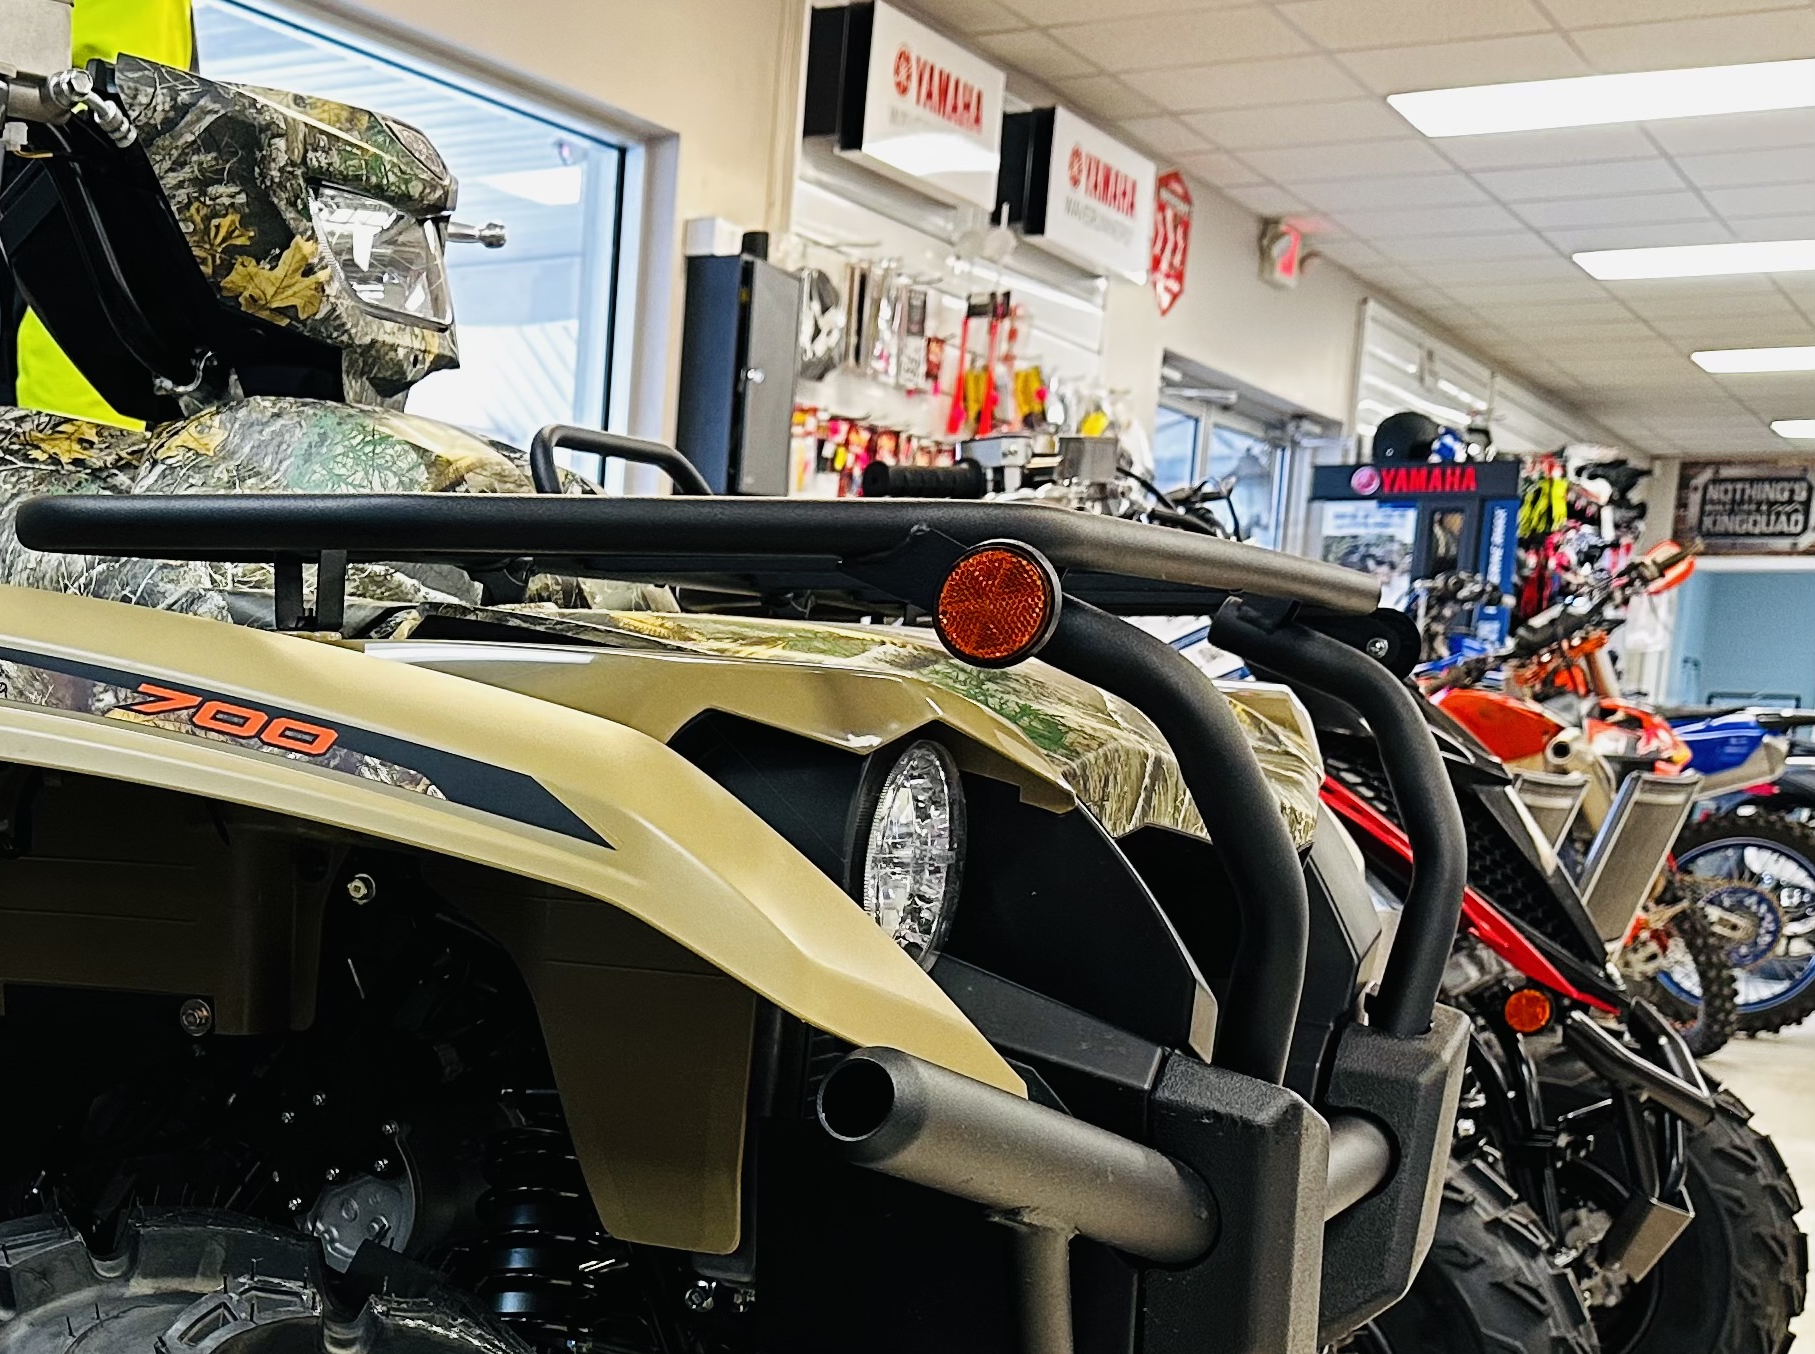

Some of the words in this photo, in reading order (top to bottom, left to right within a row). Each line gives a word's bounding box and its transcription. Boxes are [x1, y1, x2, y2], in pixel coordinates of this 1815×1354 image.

[915, 55, 983, 135] YAMAHA
[1085, 152, 1137, 219] YAMAHA
[1380, 465, 1477, 493] YAMAHA
[1705, 480, 1808, 502] NOTHING'S
[1702, 514, 1805, 535] KINGQUAD
[134, 683, 339, 756] 700
